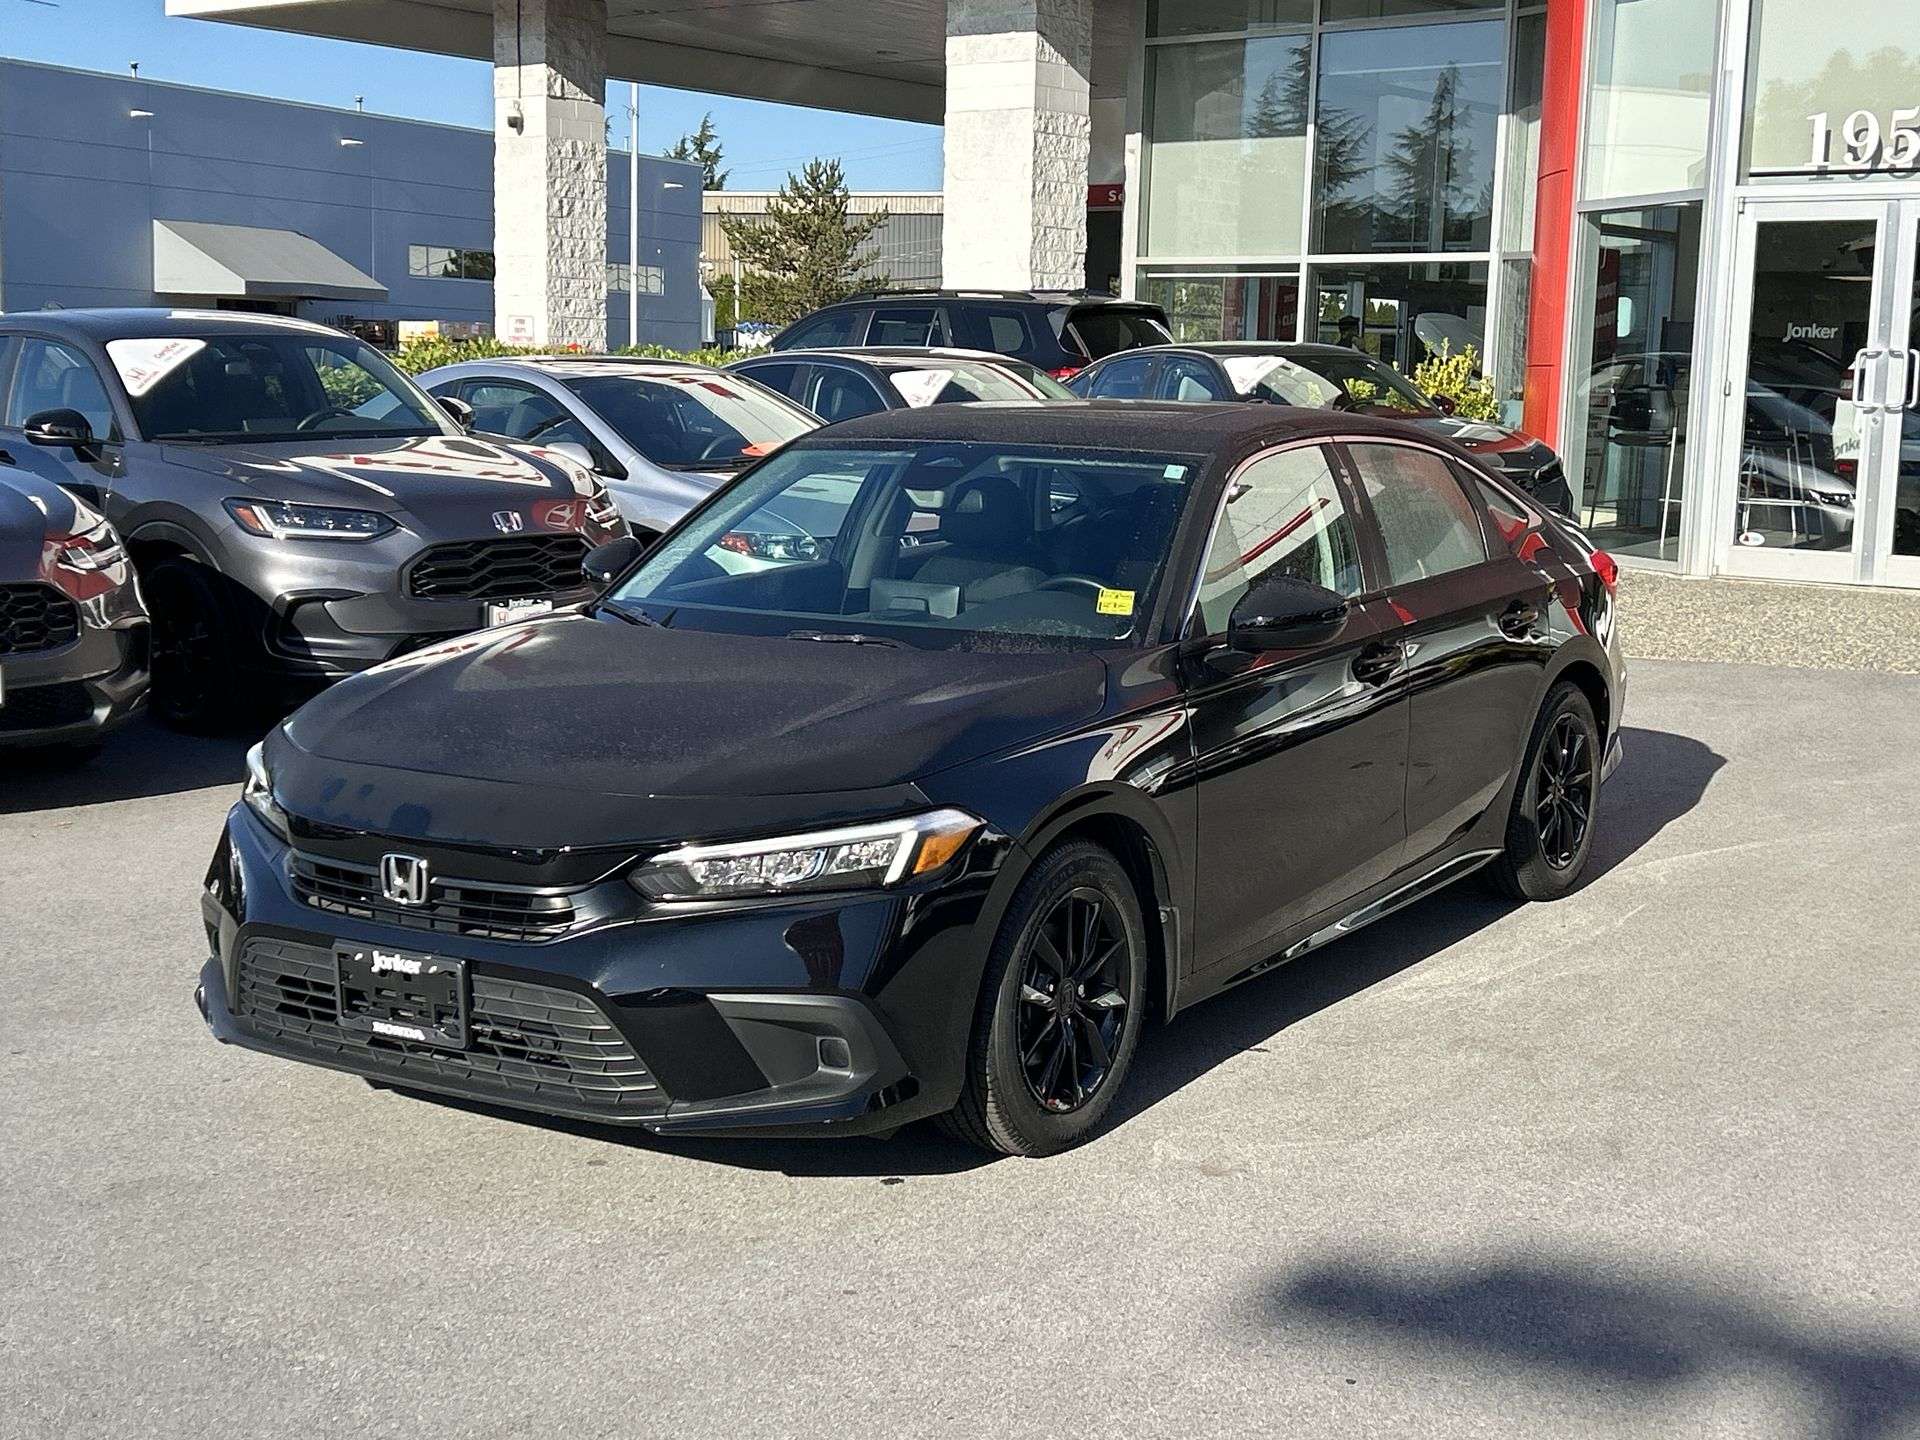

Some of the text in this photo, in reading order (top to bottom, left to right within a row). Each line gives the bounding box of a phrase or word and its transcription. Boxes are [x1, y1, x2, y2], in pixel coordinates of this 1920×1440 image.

[1782, 322, 1839, 342] Jonker
[371, 950, 422, 975] Jonker
[372, 1021, 426, 1041] HONDA
